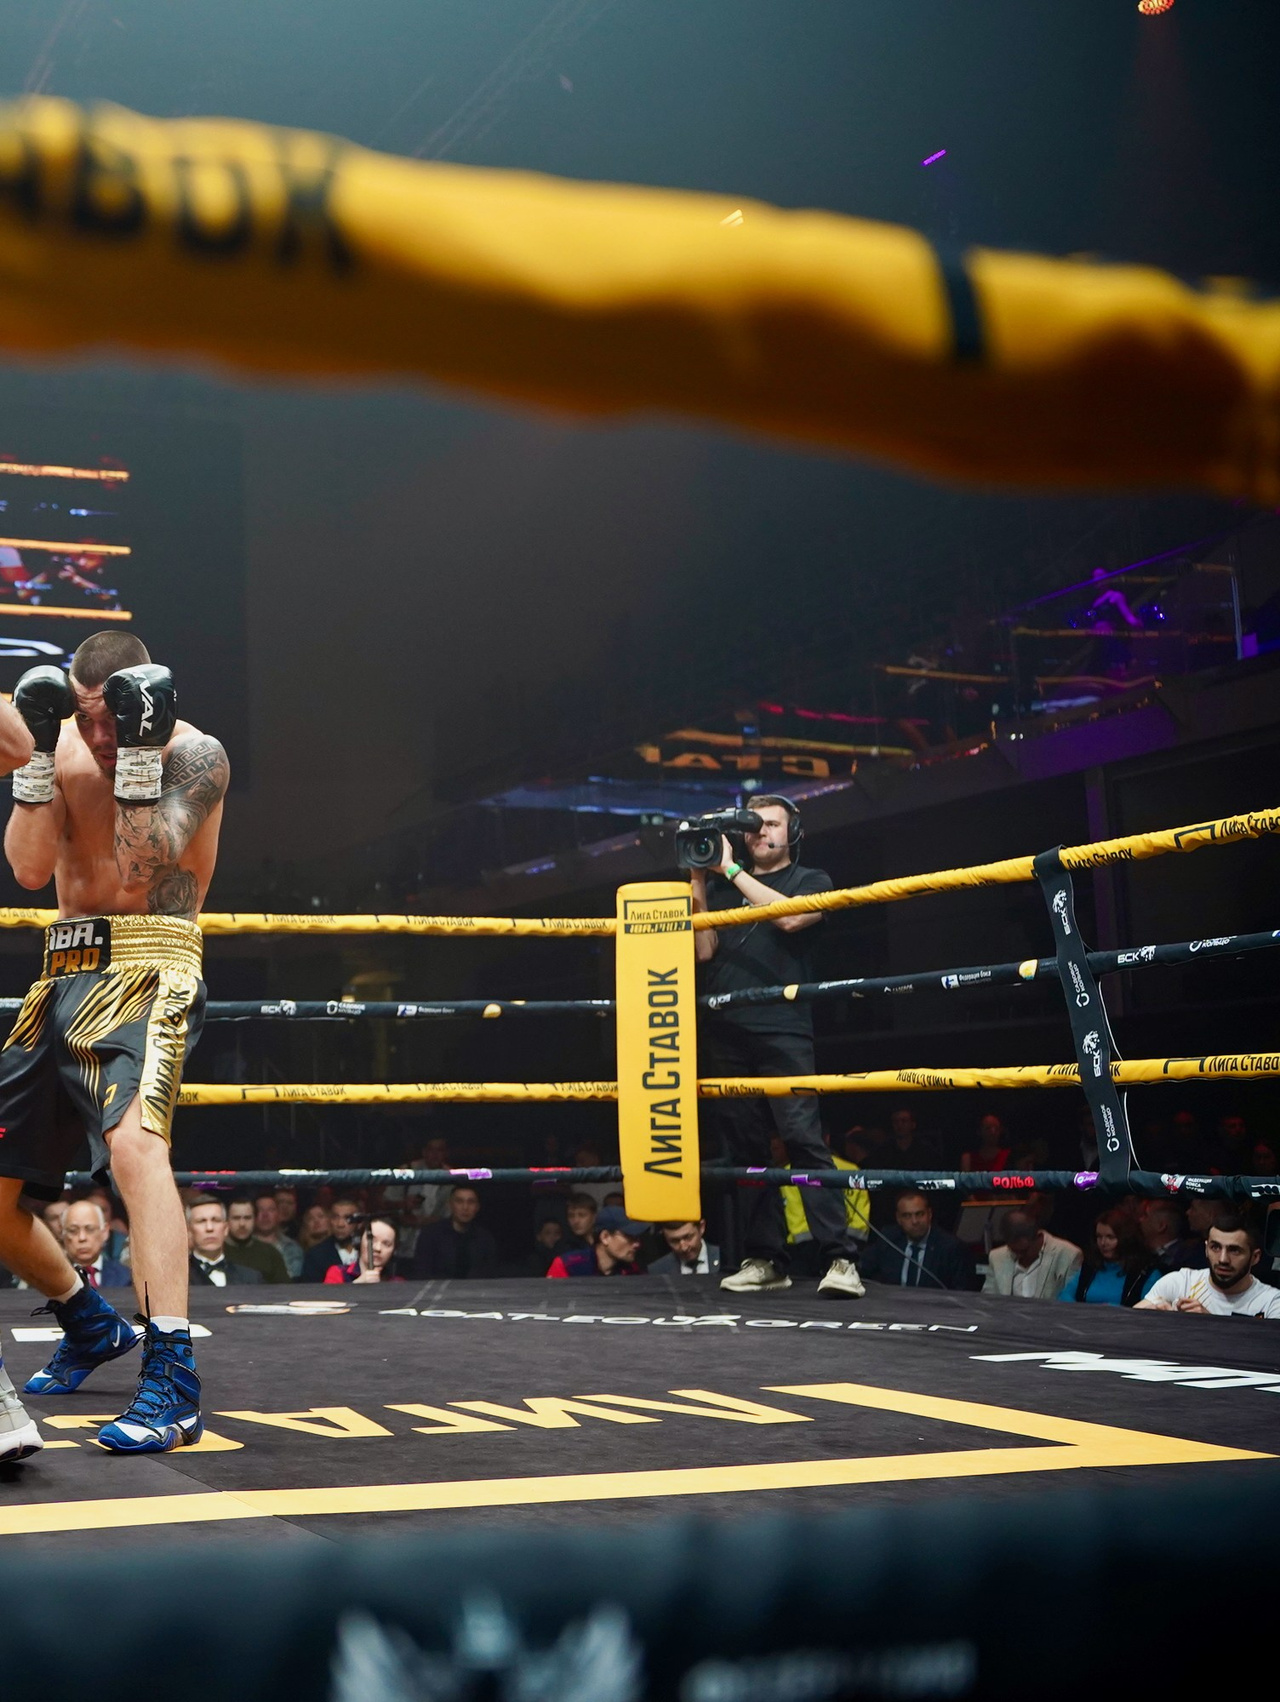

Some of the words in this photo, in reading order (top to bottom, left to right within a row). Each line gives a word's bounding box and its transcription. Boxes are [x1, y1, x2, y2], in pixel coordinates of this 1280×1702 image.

[50, 948, 100, 976] PRO
[1118, 952, 1139, 964] БСК
[642, 967, 681, 1090] СТАВОК
[1209, 1057, 1239, 1073] ЛИГА
[1241, 1055, 1280, 1072] СТАВО
[644, 1098, 683, 1179] ЛИГА
